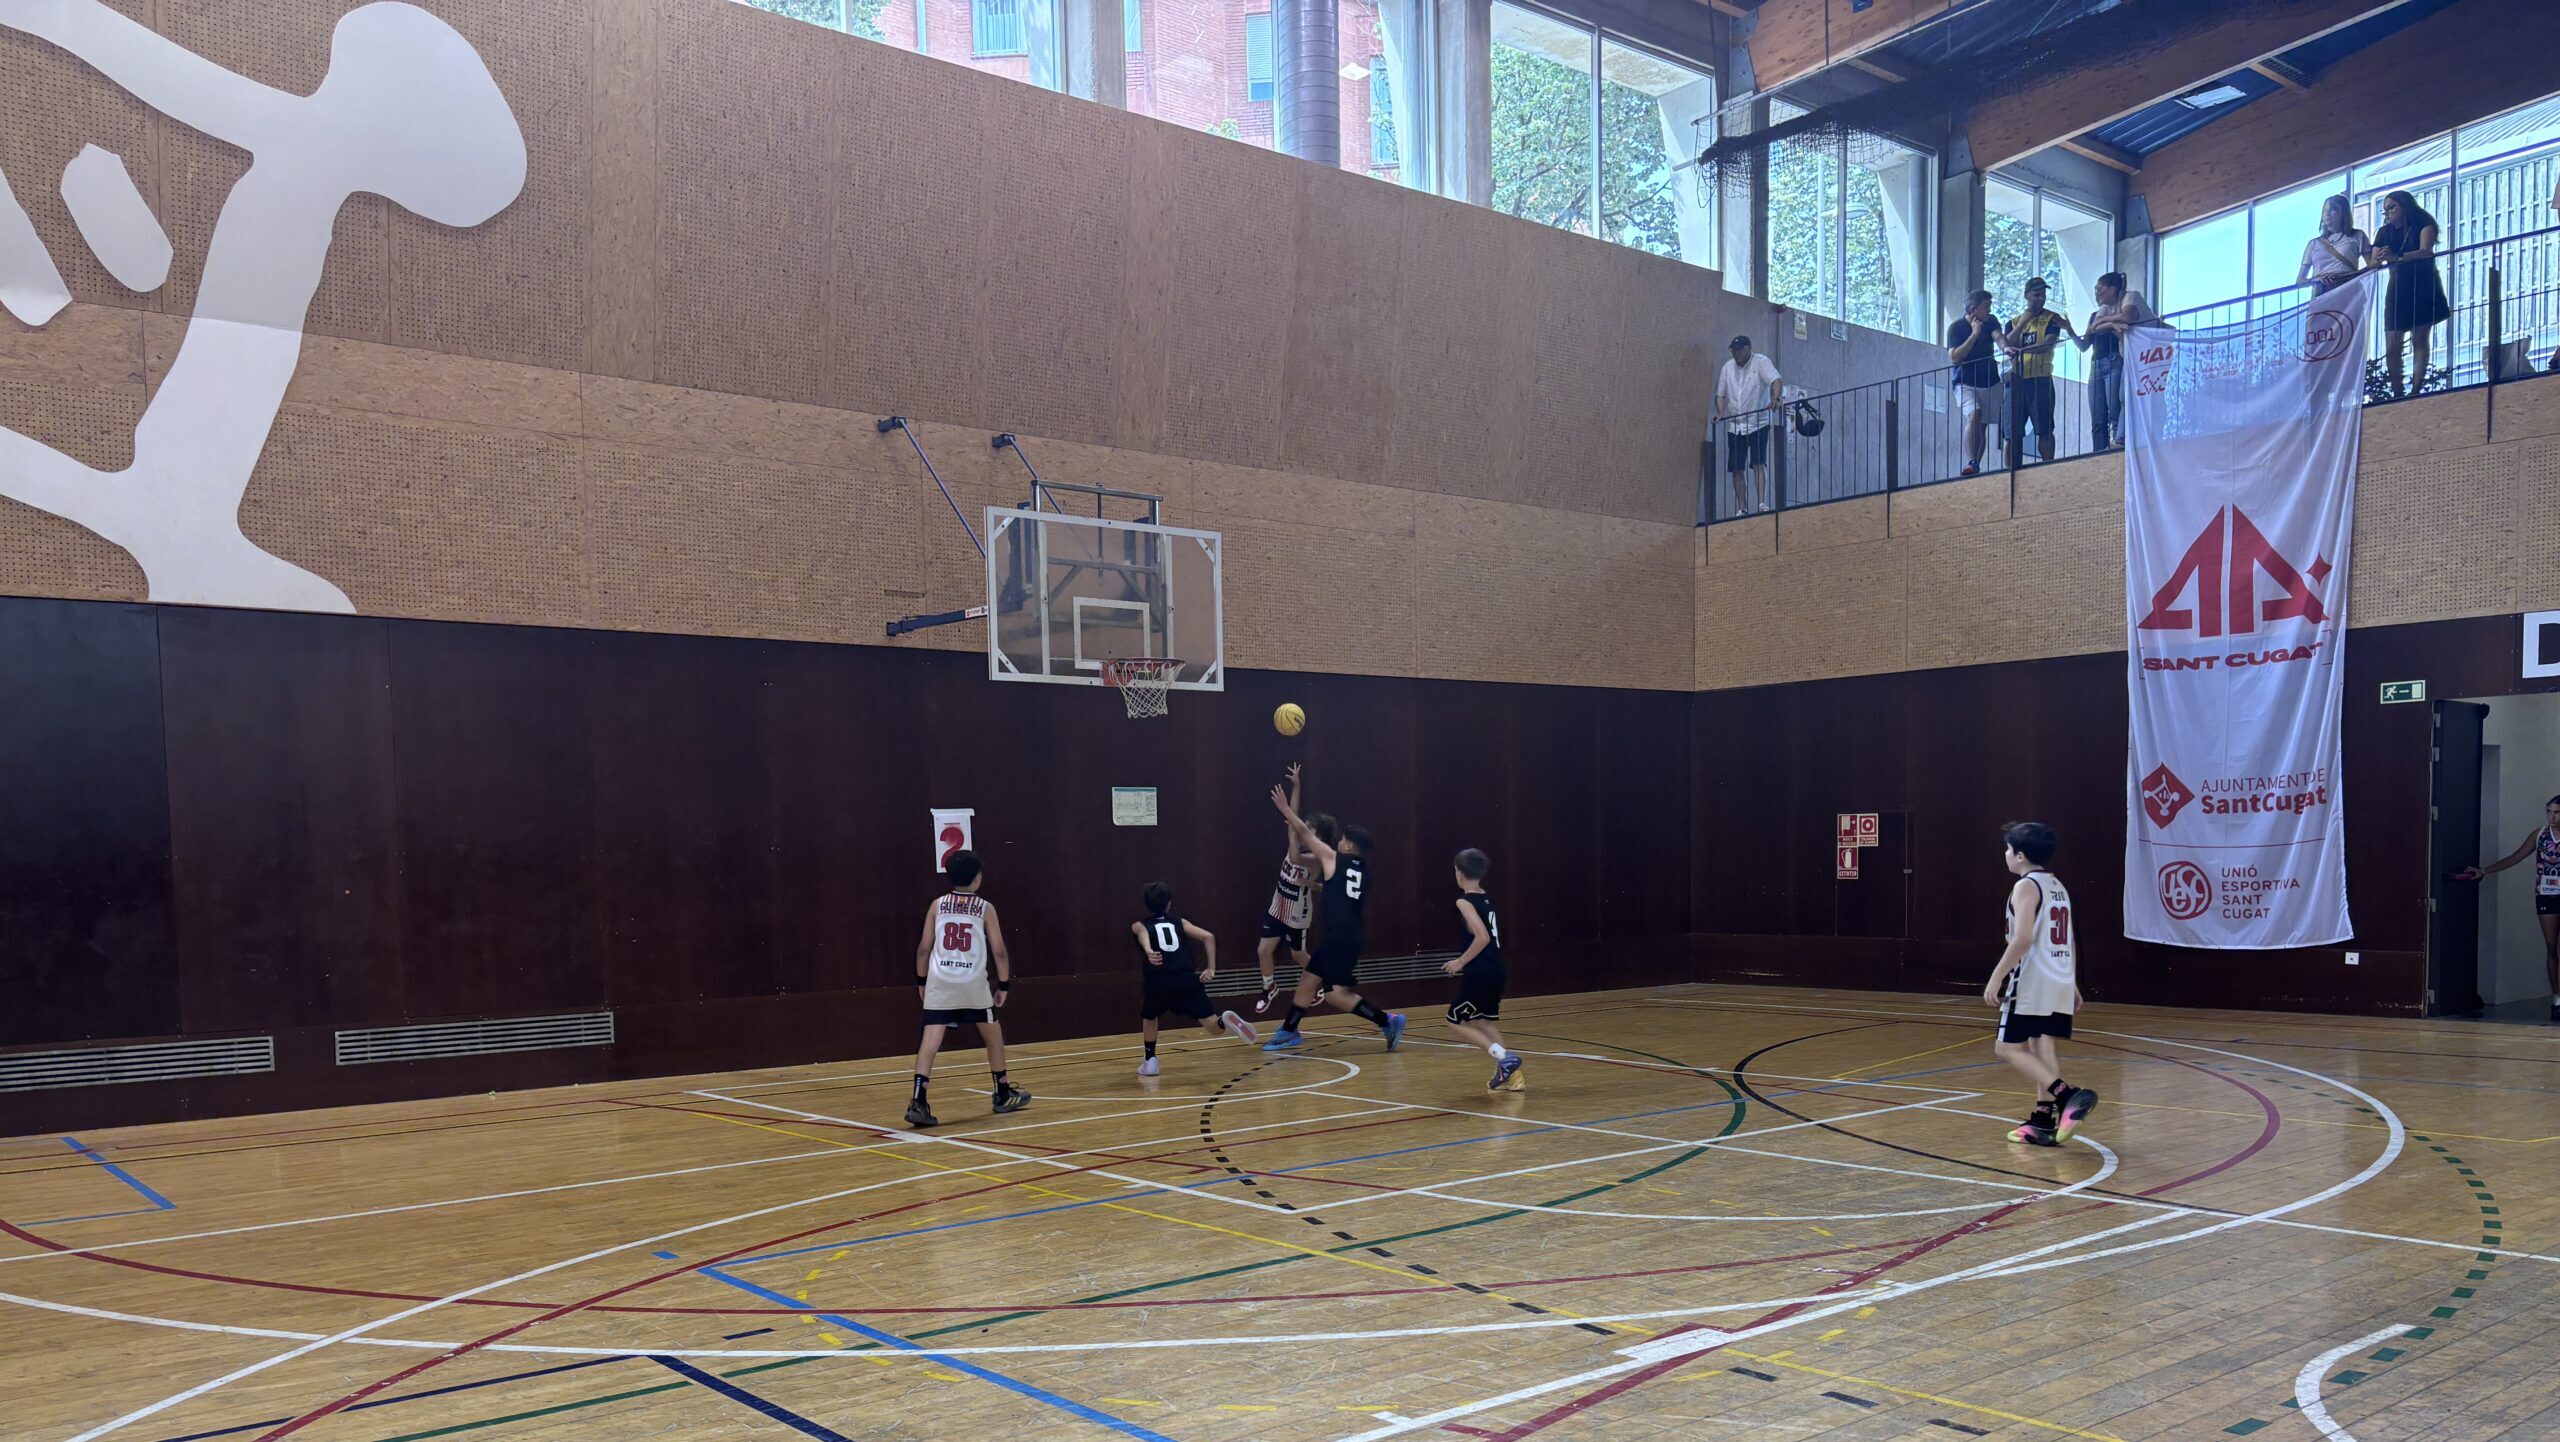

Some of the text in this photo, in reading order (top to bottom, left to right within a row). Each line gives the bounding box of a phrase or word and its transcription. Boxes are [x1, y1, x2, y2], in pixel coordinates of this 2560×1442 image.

[2143, 641, 2323, 672] SANT CUGAT
[2201, 772, 2311, 793] AJUNTAMENT
[2221, 864, 2258, 878] UNIÓ
[1345, 868, 1363, 900] 2
[2221, 878, 2301, 892] ESPORTIVA
[2222, 894, 2262, 905] SANT
[2050, 906, 2069, 945] 30
[2222, 908, 2270, 919] CUGAT
[943, 922, 973, 952] 85
[1155, 922, 1180, 952] 0
